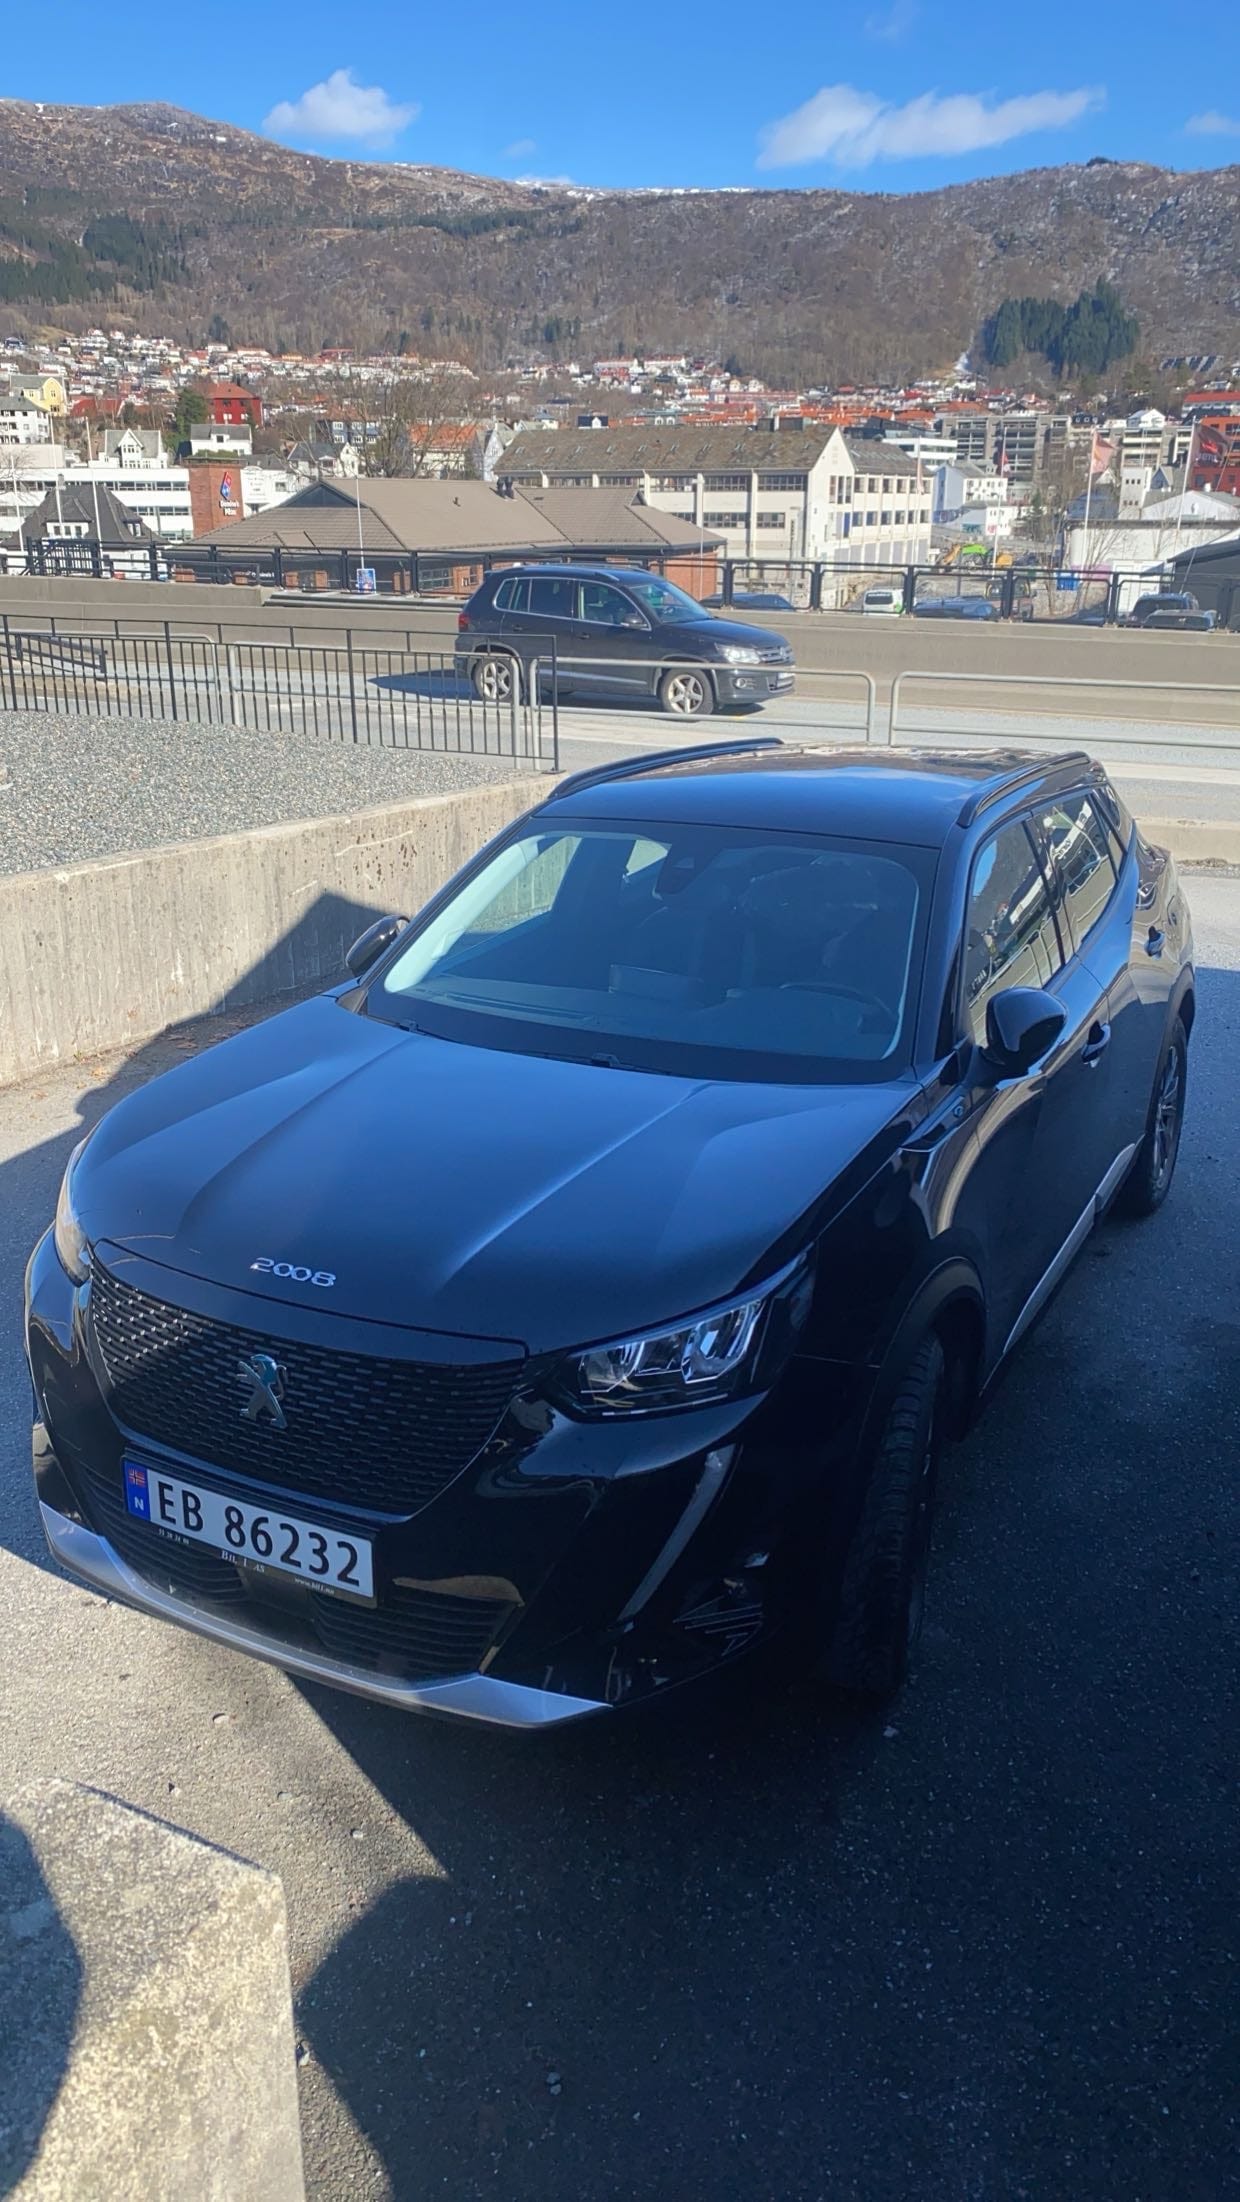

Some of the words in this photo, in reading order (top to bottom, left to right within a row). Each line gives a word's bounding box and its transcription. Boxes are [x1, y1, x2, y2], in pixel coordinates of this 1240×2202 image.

[250, 1257, 336, 1287] 2008
[134, 1496, 145, 1511] N
[157, 1480, 204, 1533] EB
[224, 1505, 361, 1588] 86232
